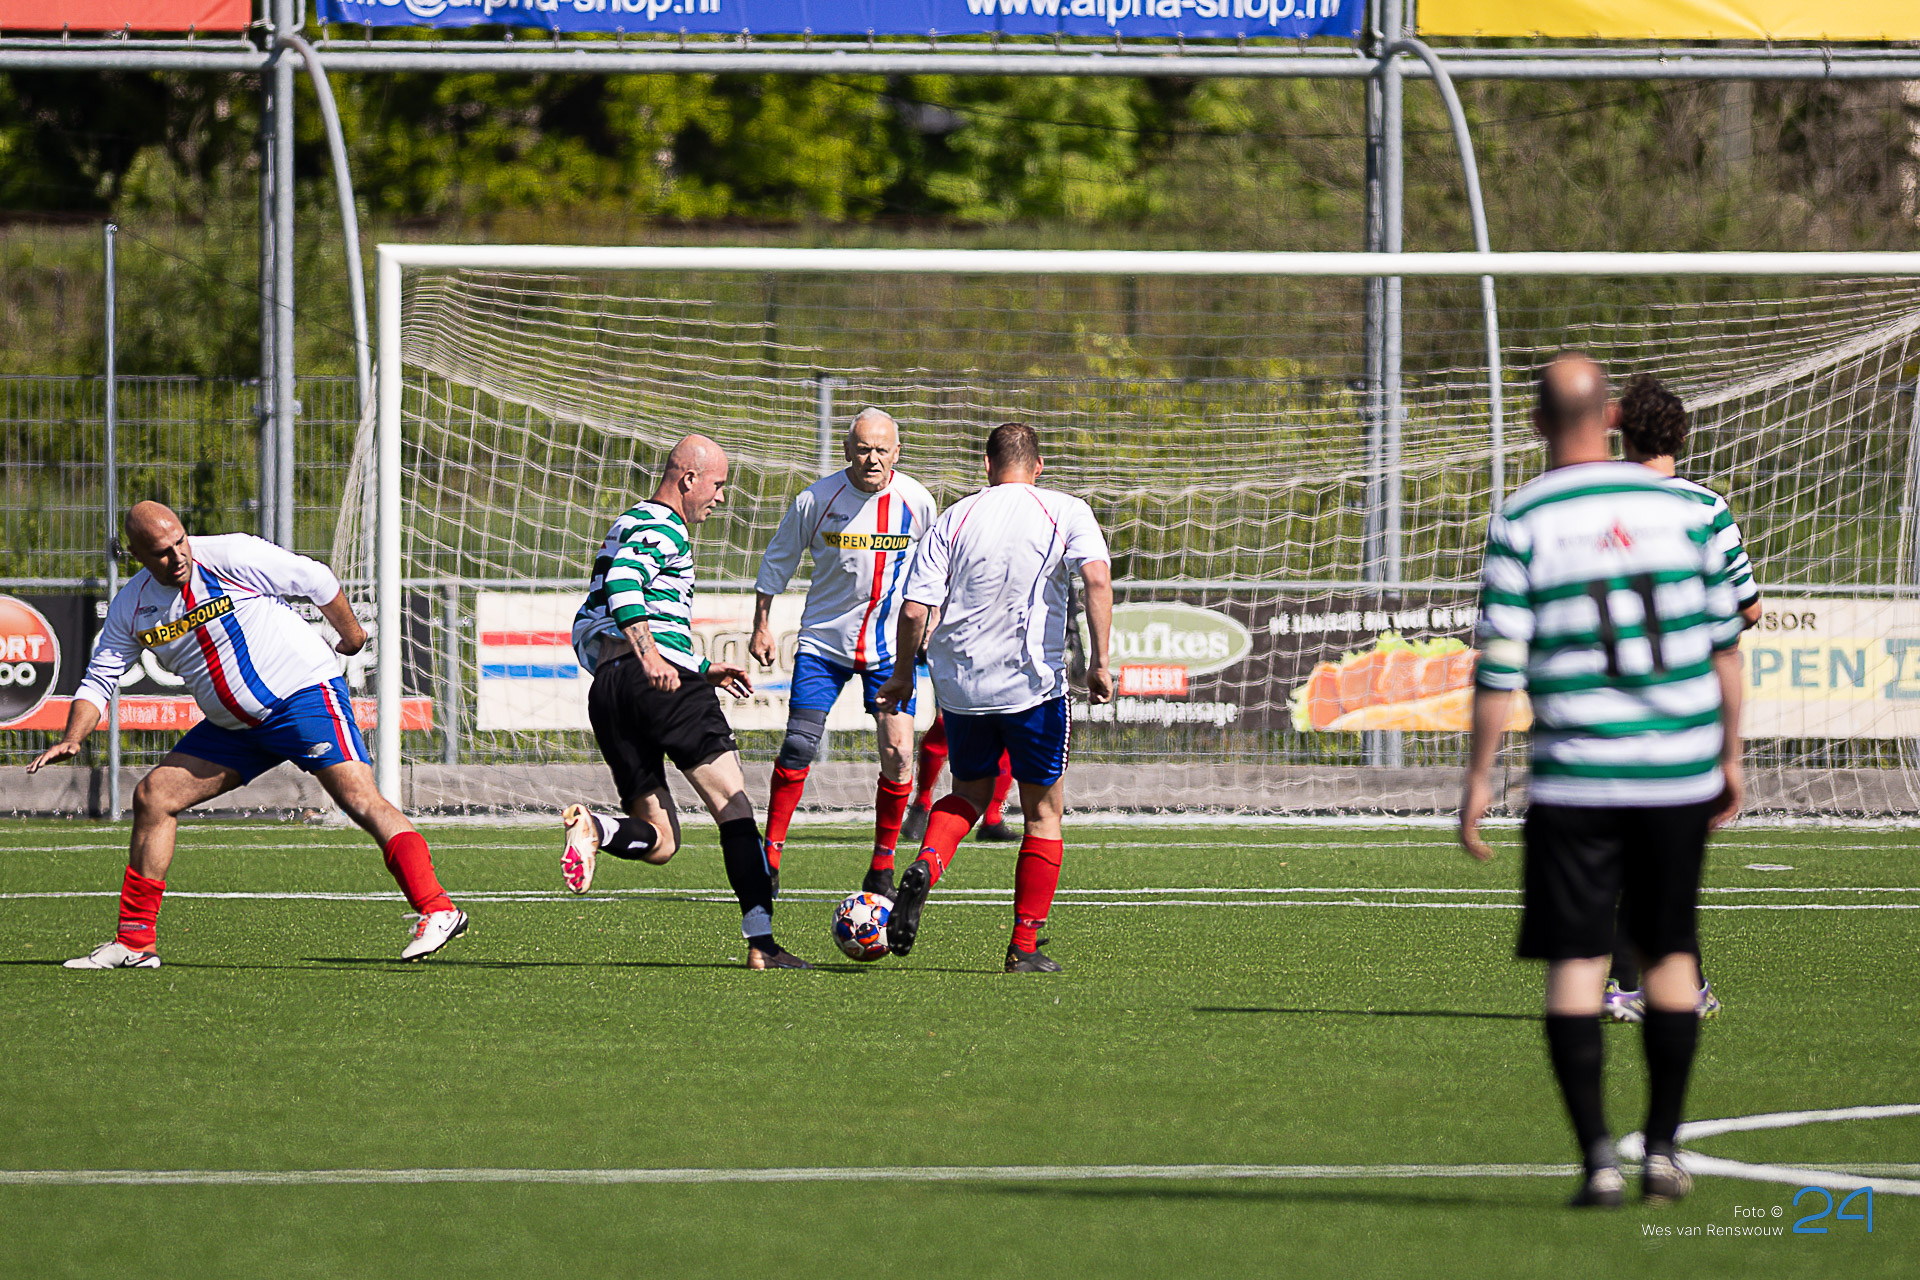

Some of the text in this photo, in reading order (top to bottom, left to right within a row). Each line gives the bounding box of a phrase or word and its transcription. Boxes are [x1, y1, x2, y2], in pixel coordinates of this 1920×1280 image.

[966, 0, 1340, 27] www.alpha-shop.nl
[873, 536, 909, 549] BOUW
[142, 623, 185, 645] OPPEN
[189, 597, 230, 627] BOUW
[1588, 574, 1665, 677] 11
[1754, 611, 1817, 631] SOR
[1123, 668, 1184, 691] WEERT
[1738, 648, 1866, 688] PEN
